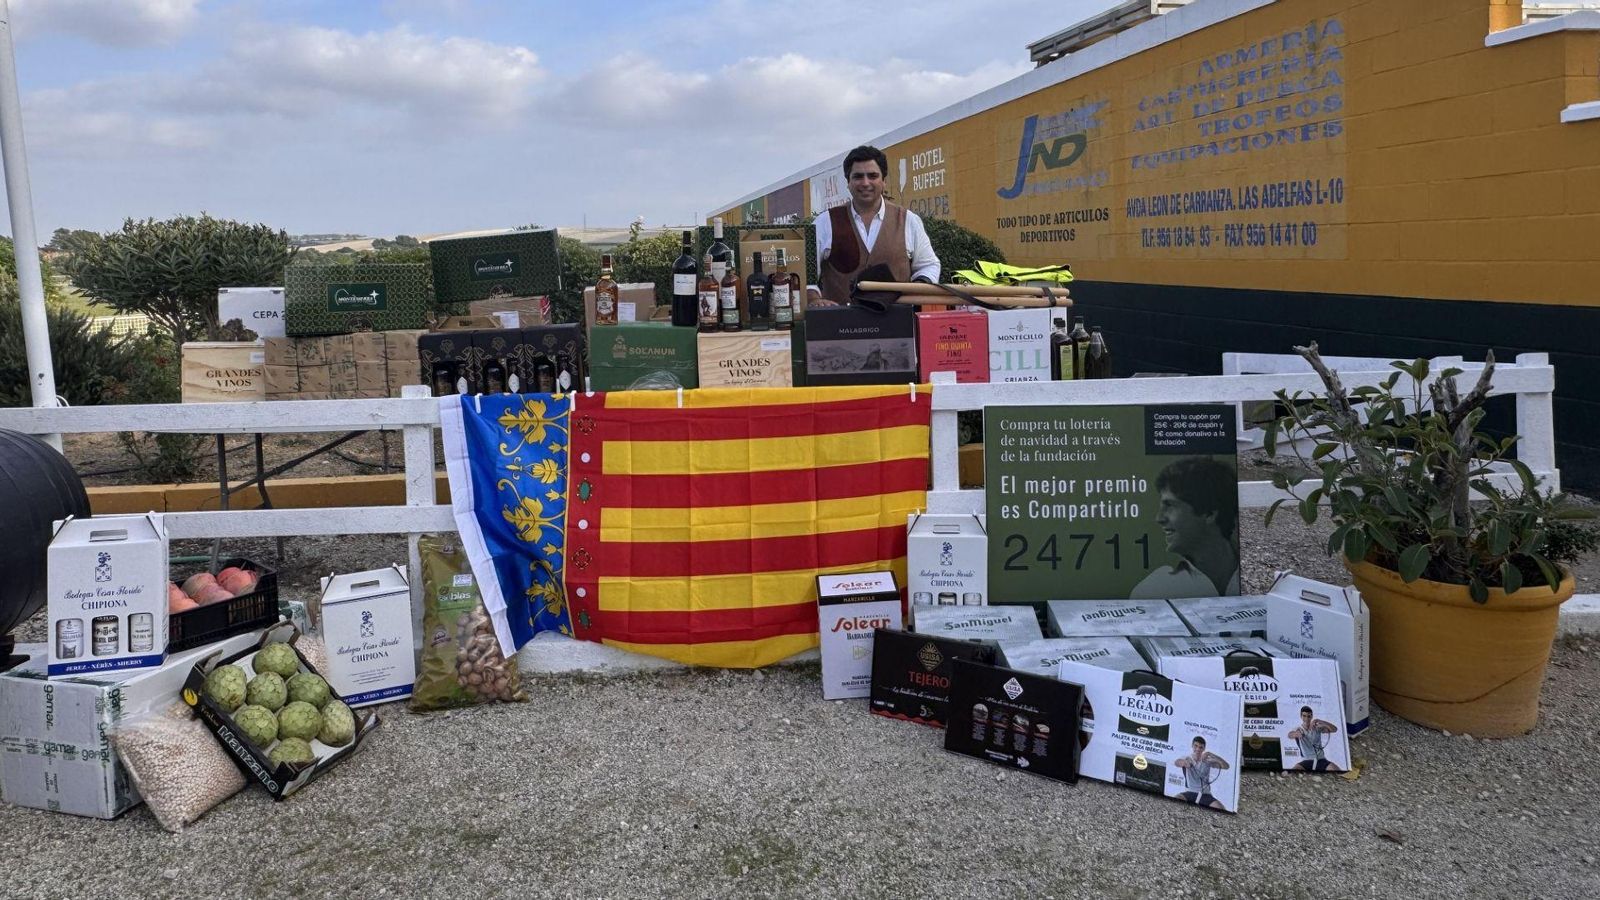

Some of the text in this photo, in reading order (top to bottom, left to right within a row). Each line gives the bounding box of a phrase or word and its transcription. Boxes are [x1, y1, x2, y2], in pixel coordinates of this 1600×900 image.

[911, 147, 945, 171] HOTEL
[912, 168, 946, 191] BUFFET
[1148, 194, 1169, 217] LEON
[1170, 192, 1182, 216] DE
[1238, 184, 1259, 210] LAS
[1261, 179, 1313, 209] ADELFAS
[1316, 176, 1344, 205] L-10
[997, 207, 1110, 229] TODO TIPO DE ARTICULOS
[1020, 228, 1076, 243] DEPORTIVOS
[1174, 226, 1183, 247] 18
[1199, 224, 1211, 247] 93
[1224, 223, 1244, 247] FAX
[1246, 222, 1266, 247] 956
[1269, 222, 1282, 247] 14
[1284, 222, 1298, 246] 41
[1301, 221, 1317, 246] 00
[252, 310, 279, 319] CEPA
[997, 333, 1044, 341] MONTECILLO
[628, 347, 676, 356] SOLANUM
[718, 357, 772, 369] GRANDES
[206, 368, 262, 379] GRANDES
[728, 368, 763, 379] VINOS
[215, 379, 252, 388] VINOS
[1153, 413, 1179, 421] Compra
[1189, 413, 1209, 422] cupón
[1000, 417, 1112, 433] Compra tu lotería
[1153, 421, 1168, 429] 25€
[1173, 421, 1187, 429] 20€
[1000, 433, 1121, 447] de navidad a través
[1000, 449, 1097, 462] de la fundación
[1001, 475, 1148, 497] El mejor premio
[1001, 499, 1139, 522] es Compartirlo
[1003, 532, 1150, 571] 24711
[832, 581, 882, 590] Solear
[930, 579, 964, 588] CHIPIONA
[81, 599, 128, 610] CHIPIONA
[831, 616, 892, 633] Solear
[351, 651, 389, 663] CHIPIONA
[908, 671, 949, 688] TEJERO
[1223, 681, 1279, 692] LEGADO
[1118, 695, 1174, 716] LEGADO
[1111, 733, 1131, 741] PALETA
[217, 725, 279, 793] Manzano
